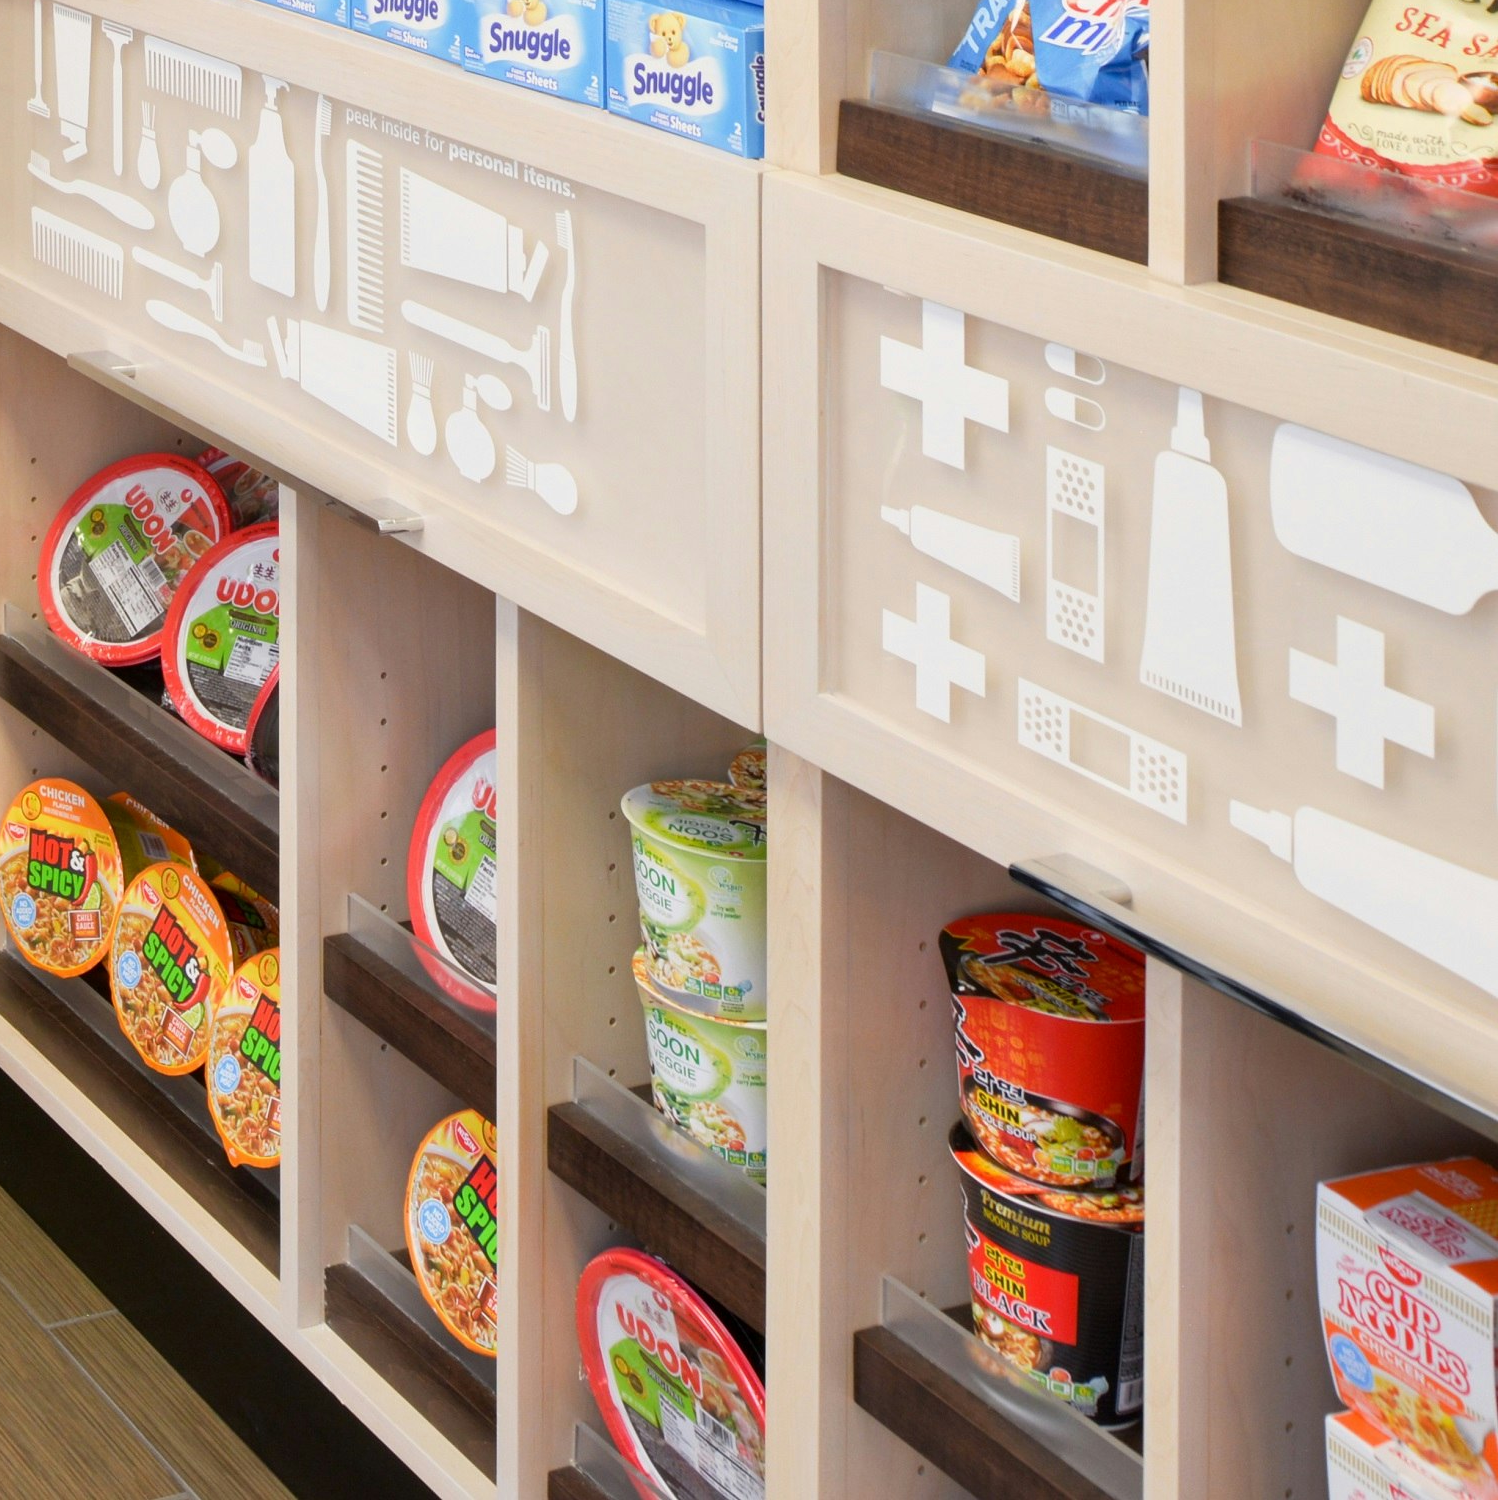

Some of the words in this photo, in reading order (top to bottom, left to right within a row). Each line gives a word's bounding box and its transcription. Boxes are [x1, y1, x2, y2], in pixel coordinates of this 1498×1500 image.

[402, 30, 428, 50] Sheets
[489, 22, 571, 62] Snuggle
[1396, 6, 1452, 48] SEA
[526, 70, 558, 91] Sheets
[633, 62, 714, 106] Snuggle
[345, 107, 378, 130] peek
[381, 116, 420, 146] inside
[425, 129, 444, 153] for
[449, 141, 519, 180] personal
[523, 164, 577, 200] items.
[1376, 129, 1411, 145] made
[1412, 133, 1447, 147] with
[1376, 139, 1404, 151] LOVE
[124, 482, 177, 555] UDON
[229, 618, 268, 637] ORIGINAL
[39, 784, 86, 808] CHICKEN
[52, 800, 73, 812] FLAVOR
[30, 830, 76, 869] HOT
[668, 822, 734, 843] SOON
[28, 862, 85, 901] SPICY
[76, 913, 93, 922] CHILI
[182, 875, 220, 929] CHICKEN
[74, 921, 95, 931] SAUCE
[153, 908, 198, 960] HOT
[143, 932, 195, 1004] SPICY
[705, 987, 721, 998] USA
[167, 1023, 186, 1043] SAUCE
[171, 1015, 188, 1029] CHILI
[649, 1018, 700, 1066] SOON
[654, 1047, 697, 1080] VEGGIE
[972, 1065, 1027, 1106] 라면
[977, 1091, 1021, 1124] SHIN
[1005, 1121, 1038, 1145] SOUP
[980, 1188, 1052, 1236] Premium
[982, 1207, 1019, 1241] NOODLE
[1020, 1227, 1051, 1248] SOUP
[983, 1243, 1026, 1279] 라면
[984, 1263, 1027, 1301] SHIN
[972, 1267, 1054, 1336] BLACK
[1364, 1270, 1441, 1335] CUP
[615, 1297, 703, 1399] UDON
[1338, 1277, 1471, 1396] NOODLES
